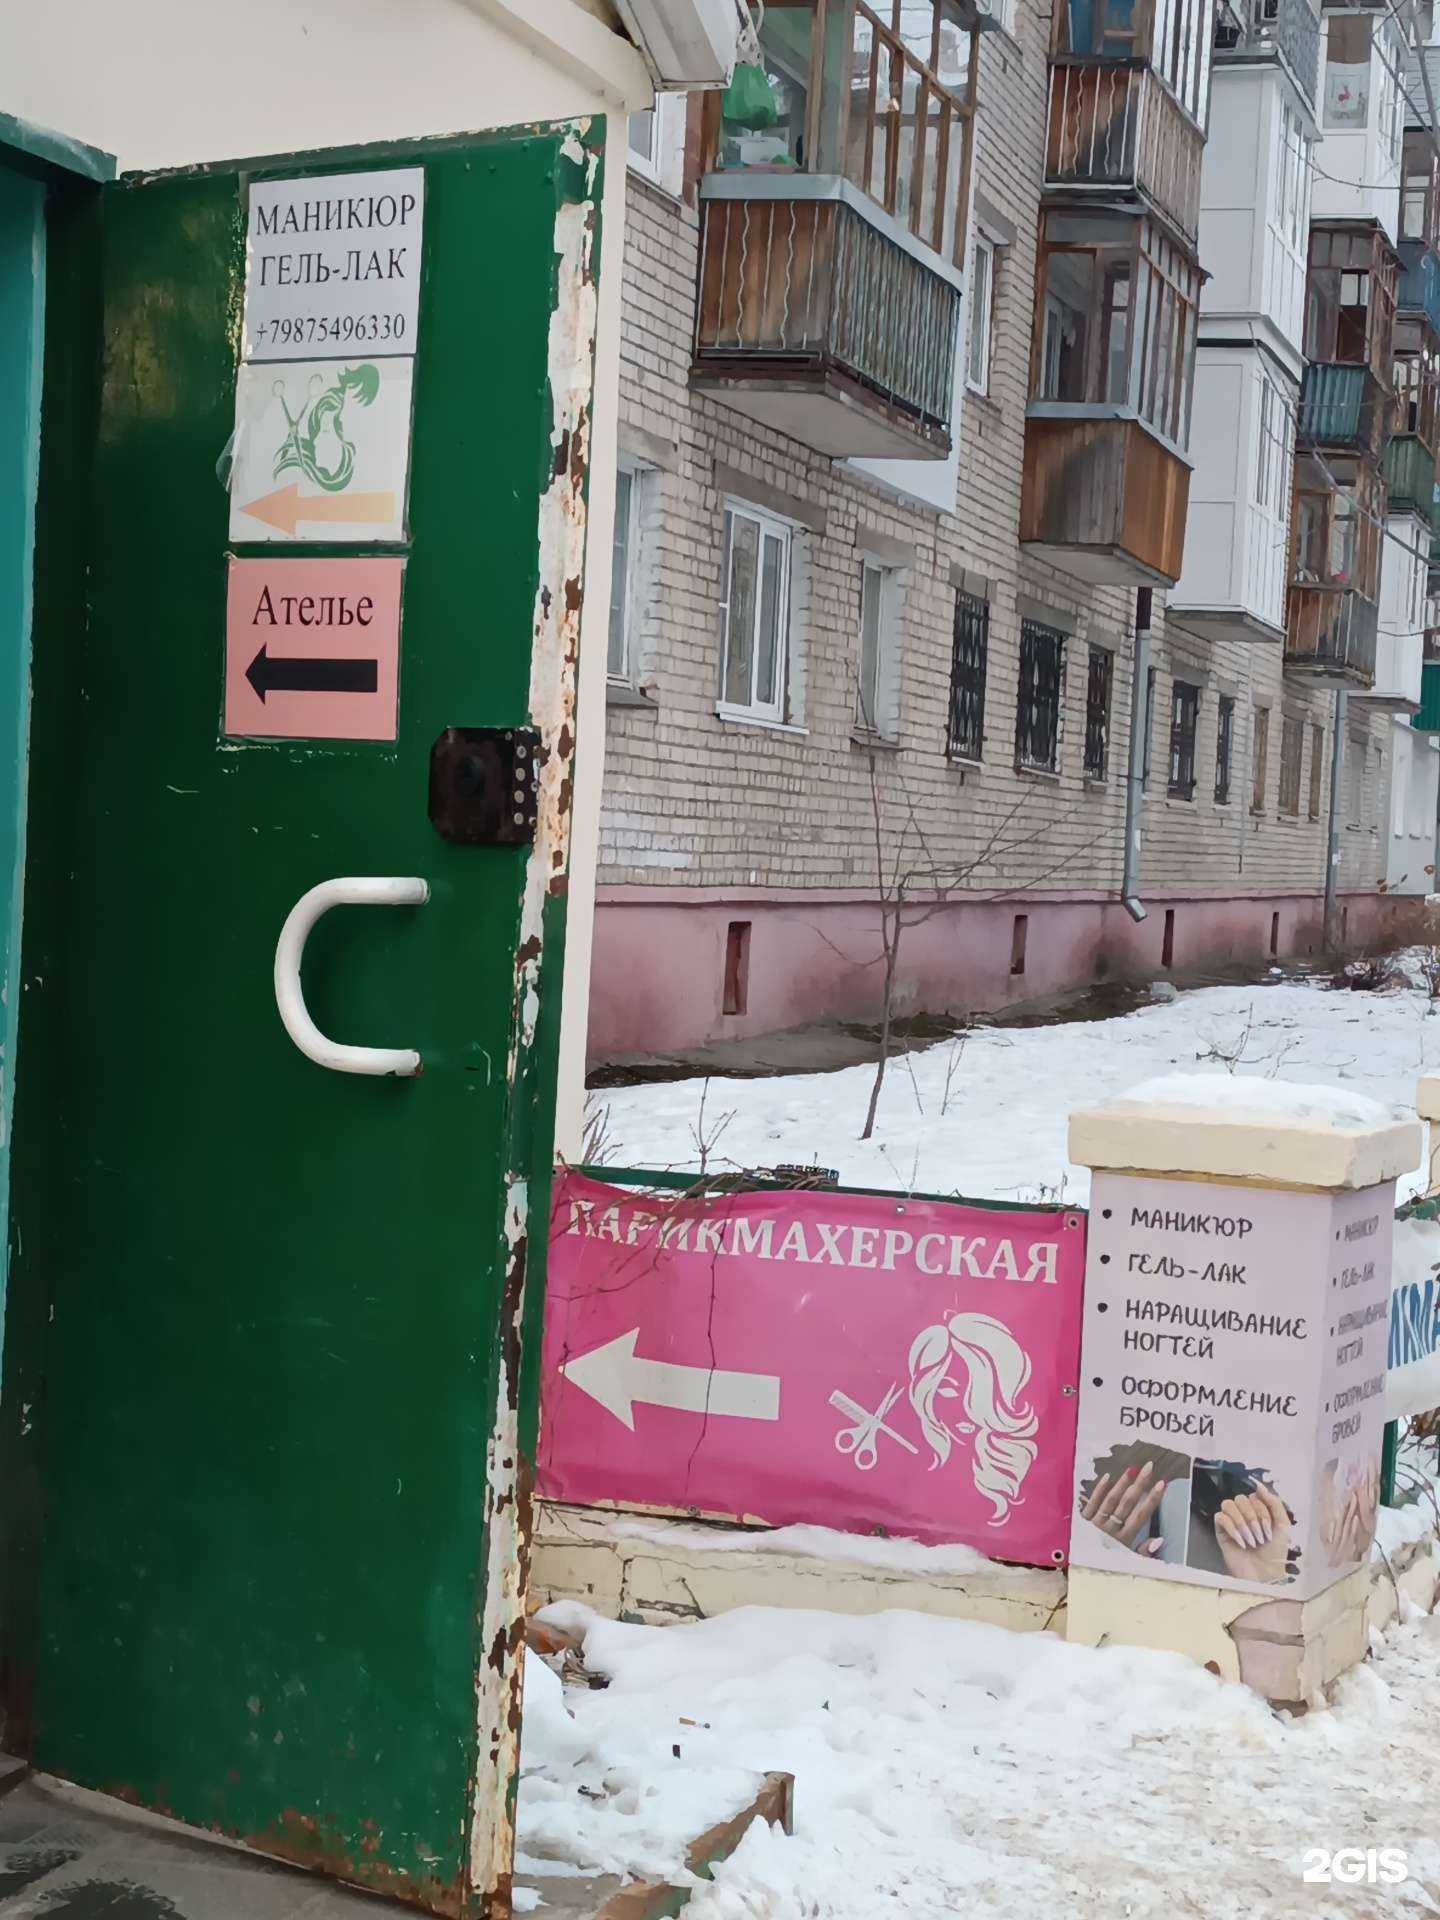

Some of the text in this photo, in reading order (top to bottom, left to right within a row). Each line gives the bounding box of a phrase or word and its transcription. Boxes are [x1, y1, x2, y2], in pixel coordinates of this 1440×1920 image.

[256, 194, 416, 236] МАНИКЮР
[260, 248, 407, 286] ГЕЛЬ-ЛАК
[256, 313, 405, 344] +79875496330
[252, 584, 373, 626] Ателье
[566, 1199, 1059, 1284] ПАРИКМАХЕРСКАЯ
[1131, 1207, 1253, 1239] МАНИКЮР
[1128, 1253, 1247, 1285] ГЕЛЬ-ЛАК
[1125, 1299, 1308, 1340] НАРАЩИВАНИЕ
[1123, 1329, 1214, 1360] НОГТЕЙ
[1121, 1375, 1298, 1417] ОФОРМЛЕНИЕ
[1120, 1406, 1215, 1437] БРОВЕЙ
